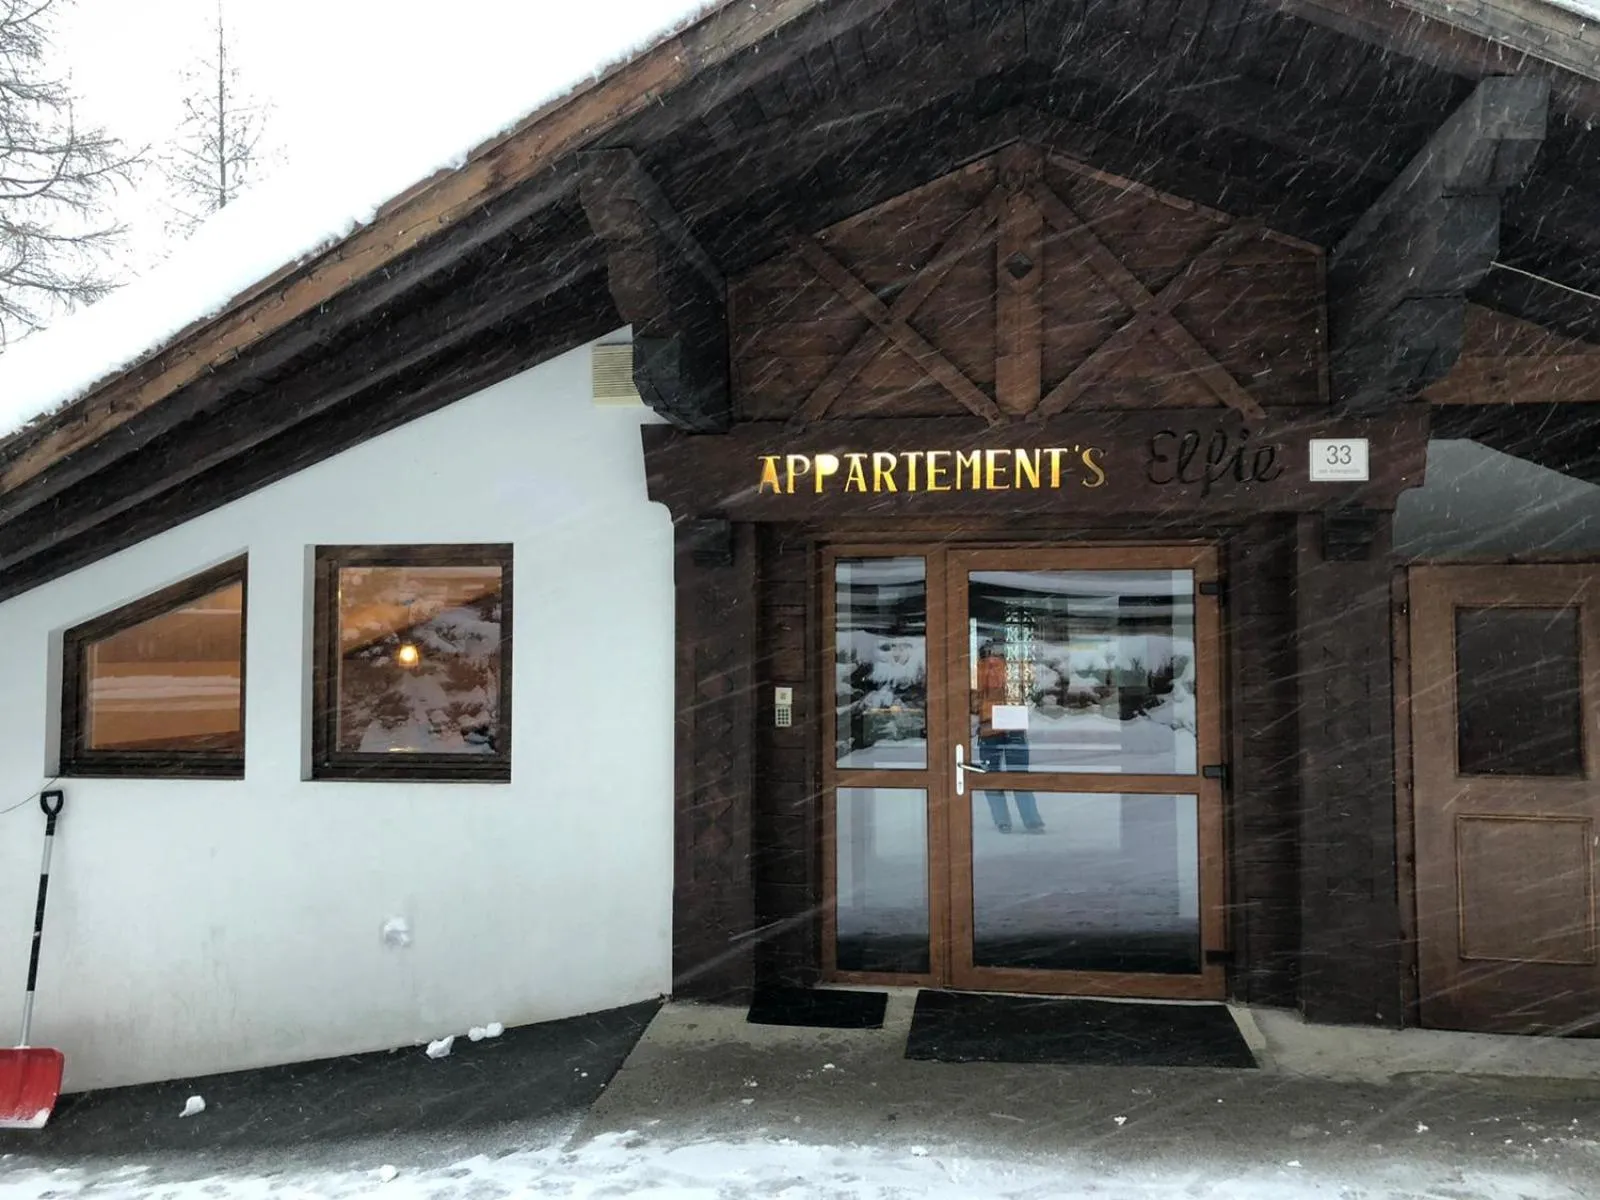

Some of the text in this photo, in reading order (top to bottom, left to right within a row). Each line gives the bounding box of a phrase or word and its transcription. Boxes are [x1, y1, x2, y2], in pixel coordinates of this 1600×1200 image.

[757, 428, 1284, 499] APPARTEMENT'S Elfie
[1326, 445, 1352, 465] 33
